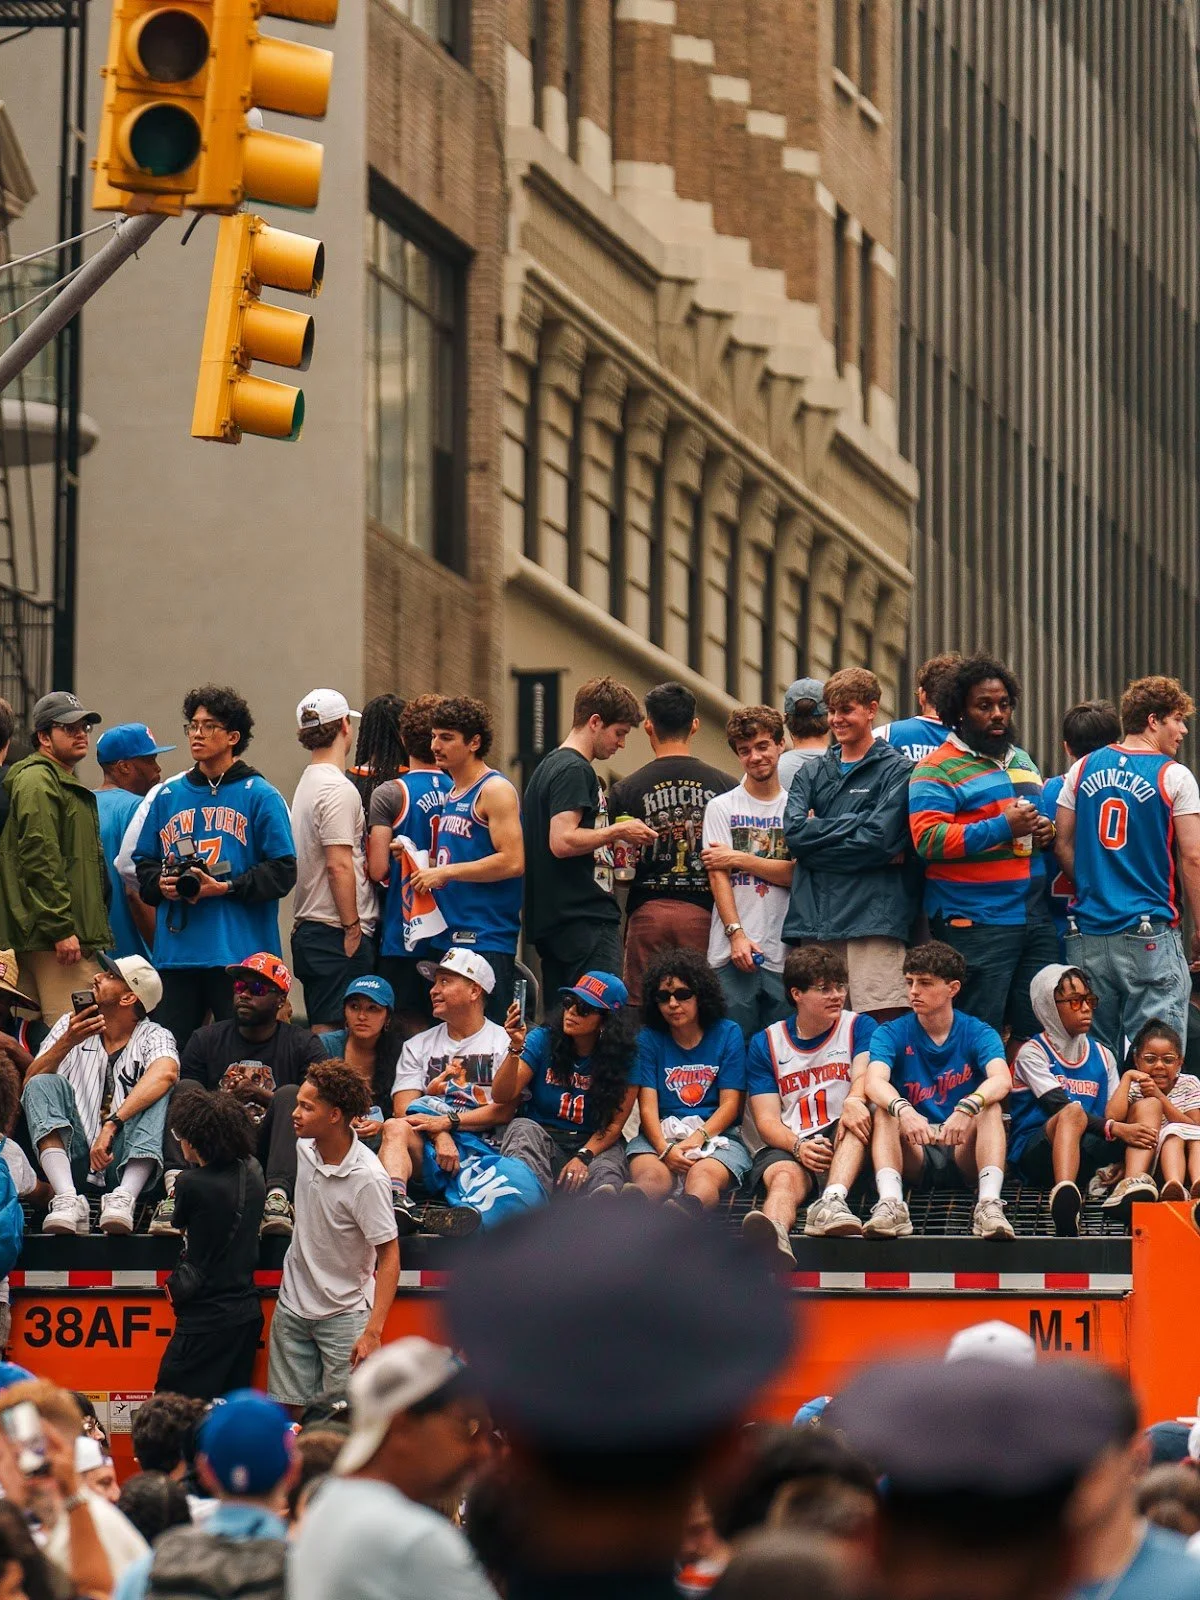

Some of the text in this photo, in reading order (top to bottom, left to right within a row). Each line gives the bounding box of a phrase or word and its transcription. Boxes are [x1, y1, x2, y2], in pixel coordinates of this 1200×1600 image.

[654, 780, 702, 791] NEW YORK
[1079, 768, 1157, 804] DIVINCENZO
[159, 805, 248, 857] NEW YORK
[1098, 796, 1129, 851] 0
[778, 1063, 851, 1097] NEW YORK
[904, 1063, 974, 1106] New York
[558, 1091, 585, 1125] 11
[799, 1089, 831, 1131] 11
